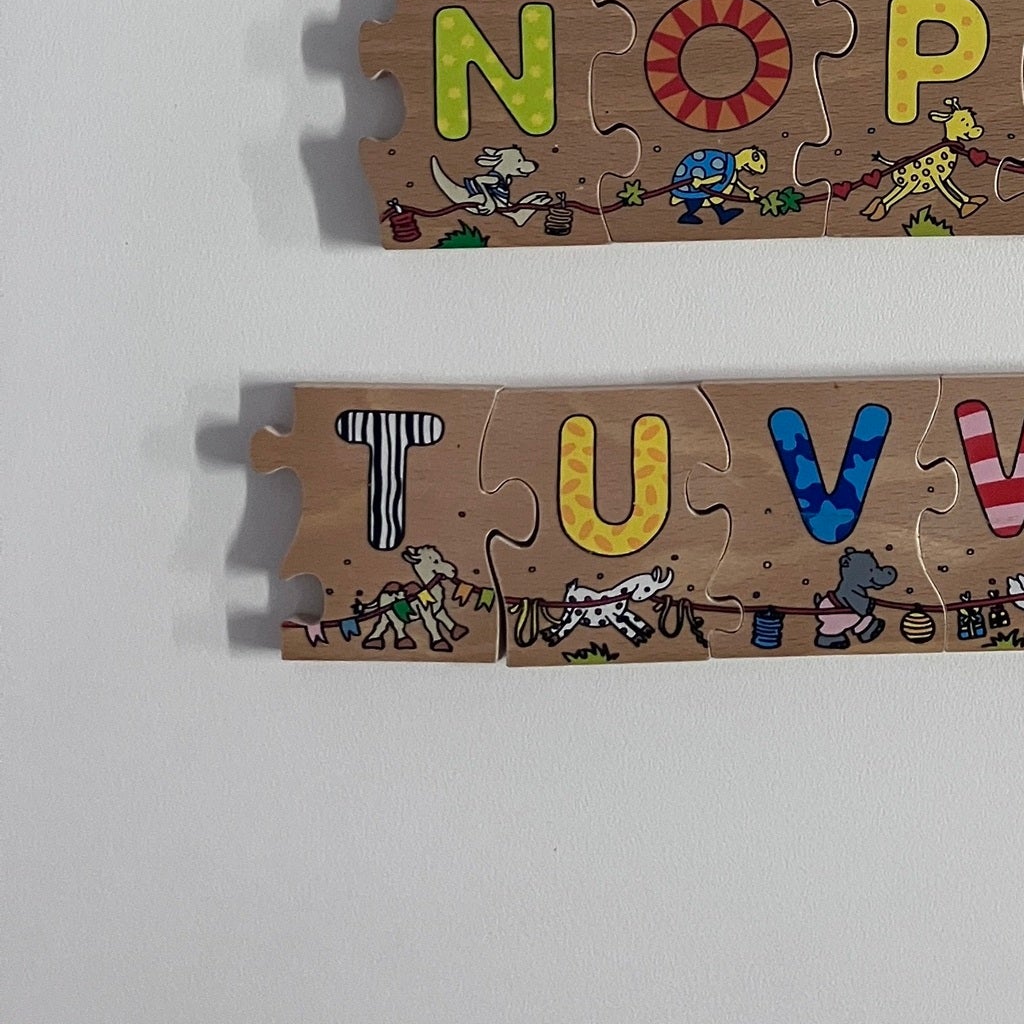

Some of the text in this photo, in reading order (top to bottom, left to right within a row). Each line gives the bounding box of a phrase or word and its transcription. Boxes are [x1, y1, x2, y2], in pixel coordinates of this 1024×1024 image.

[433, 2, 556, 141] N
[335, 408, 445, 552] T
[559, 412, 671, 557] U
[767, 402, 893, 545] V
